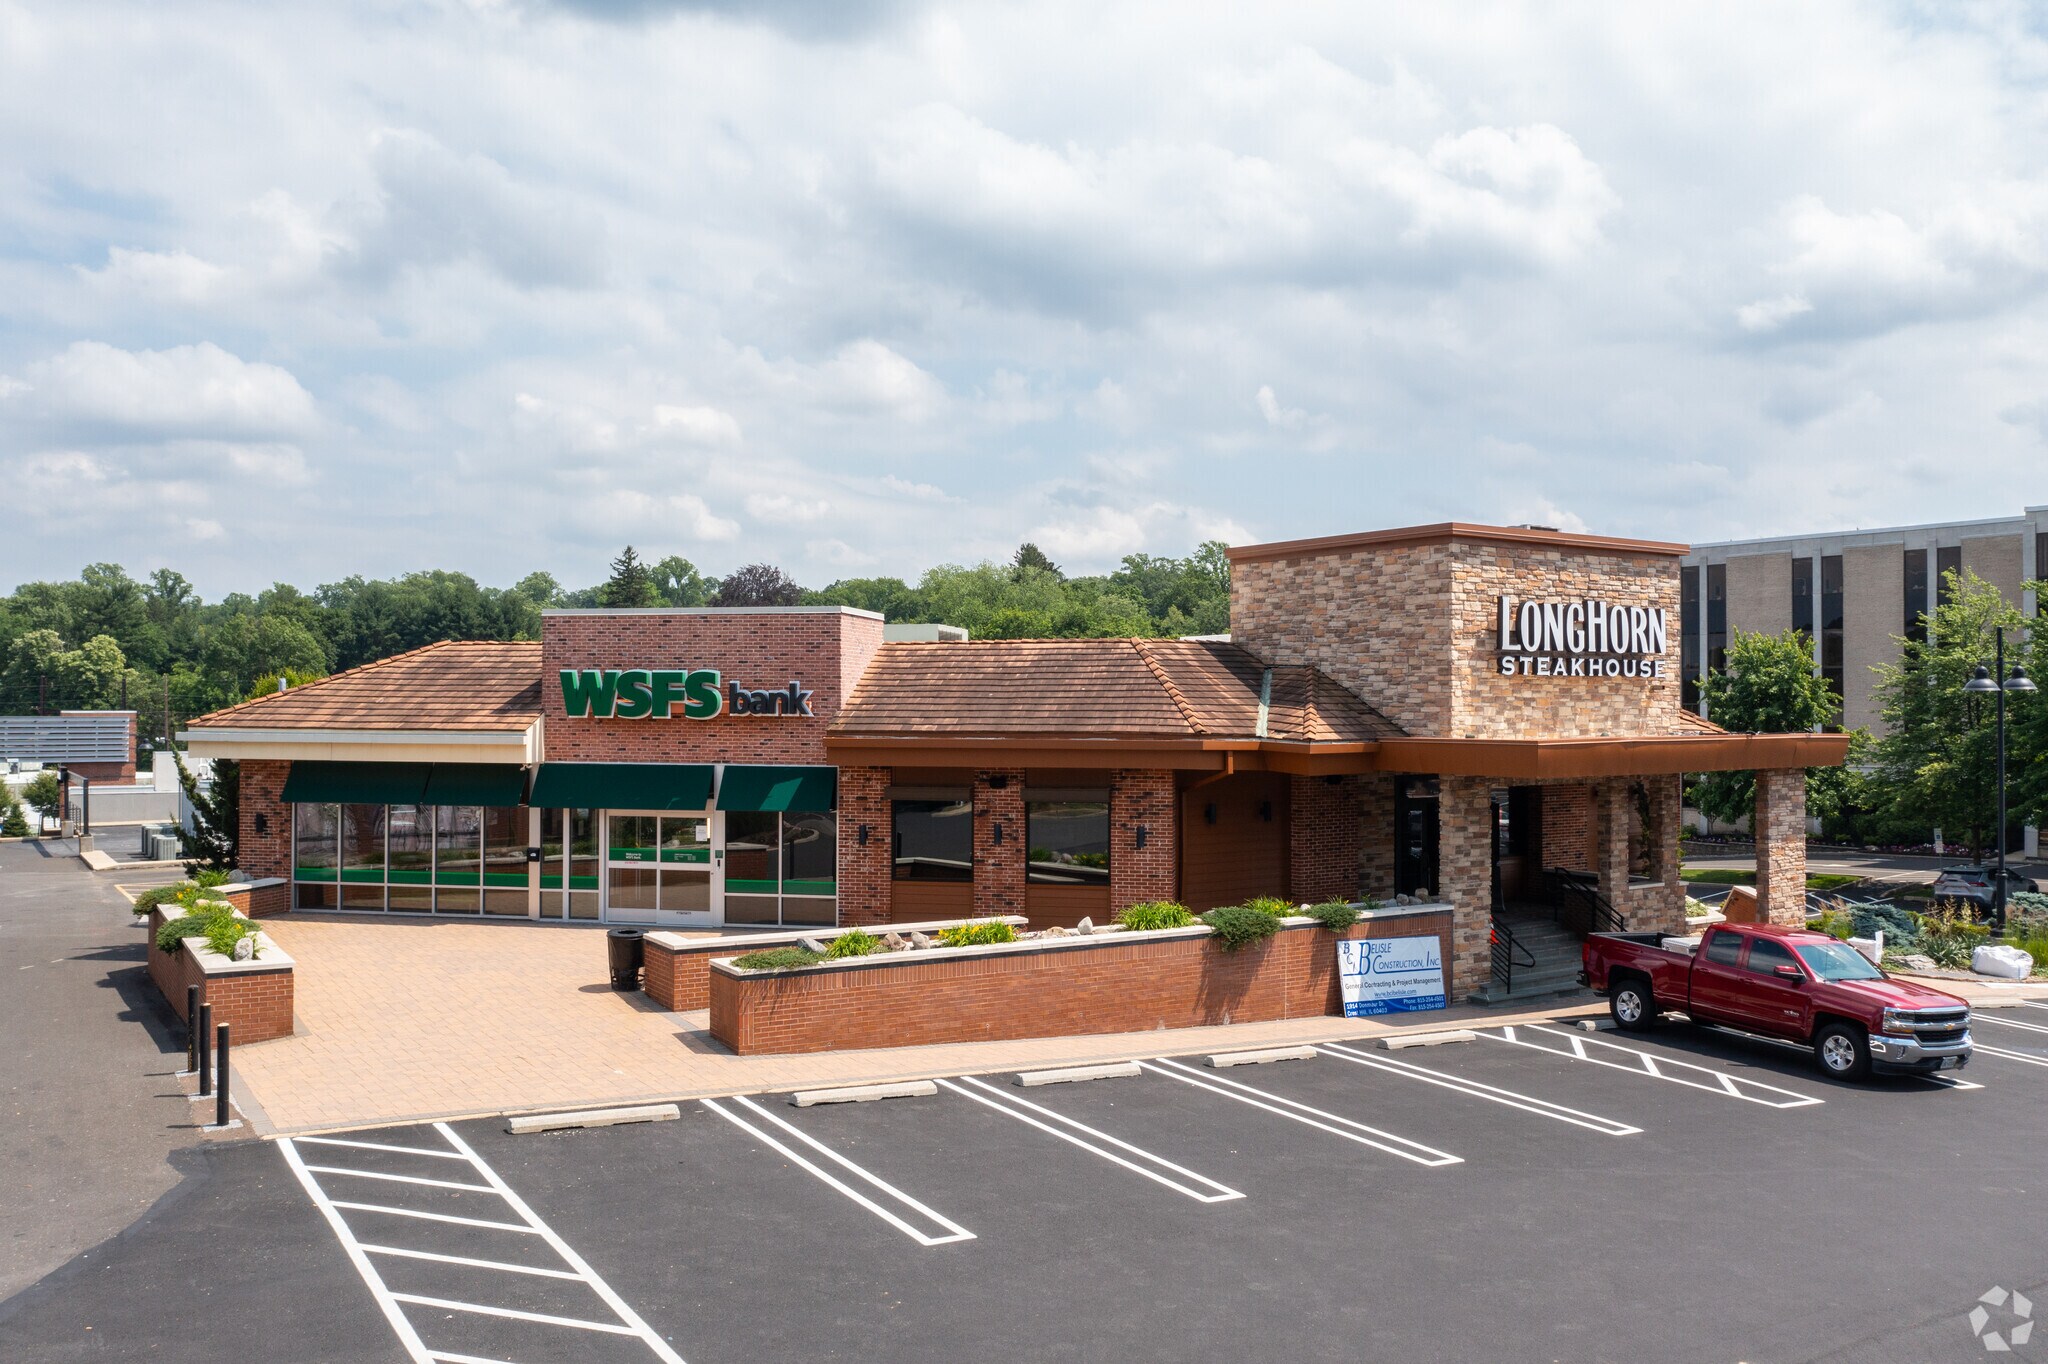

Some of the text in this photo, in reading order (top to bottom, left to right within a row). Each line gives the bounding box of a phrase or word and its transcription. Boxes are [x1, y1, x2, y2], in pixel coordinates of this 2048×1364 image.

[1497, 596, 1666, 655] LONGHORN
[1498, 656, 1666, 678] STEAKHOUSE
[559, 669, 814, 720] WSFS bank
[1359, 942, 1391, 975] BELISLE
[1345, 982, 1363, 990] General
[1365, 980, 1391, 989] Contracting
[1397, 978, 1413, 988] Project
[1413, 977, 1441, 985] Management
